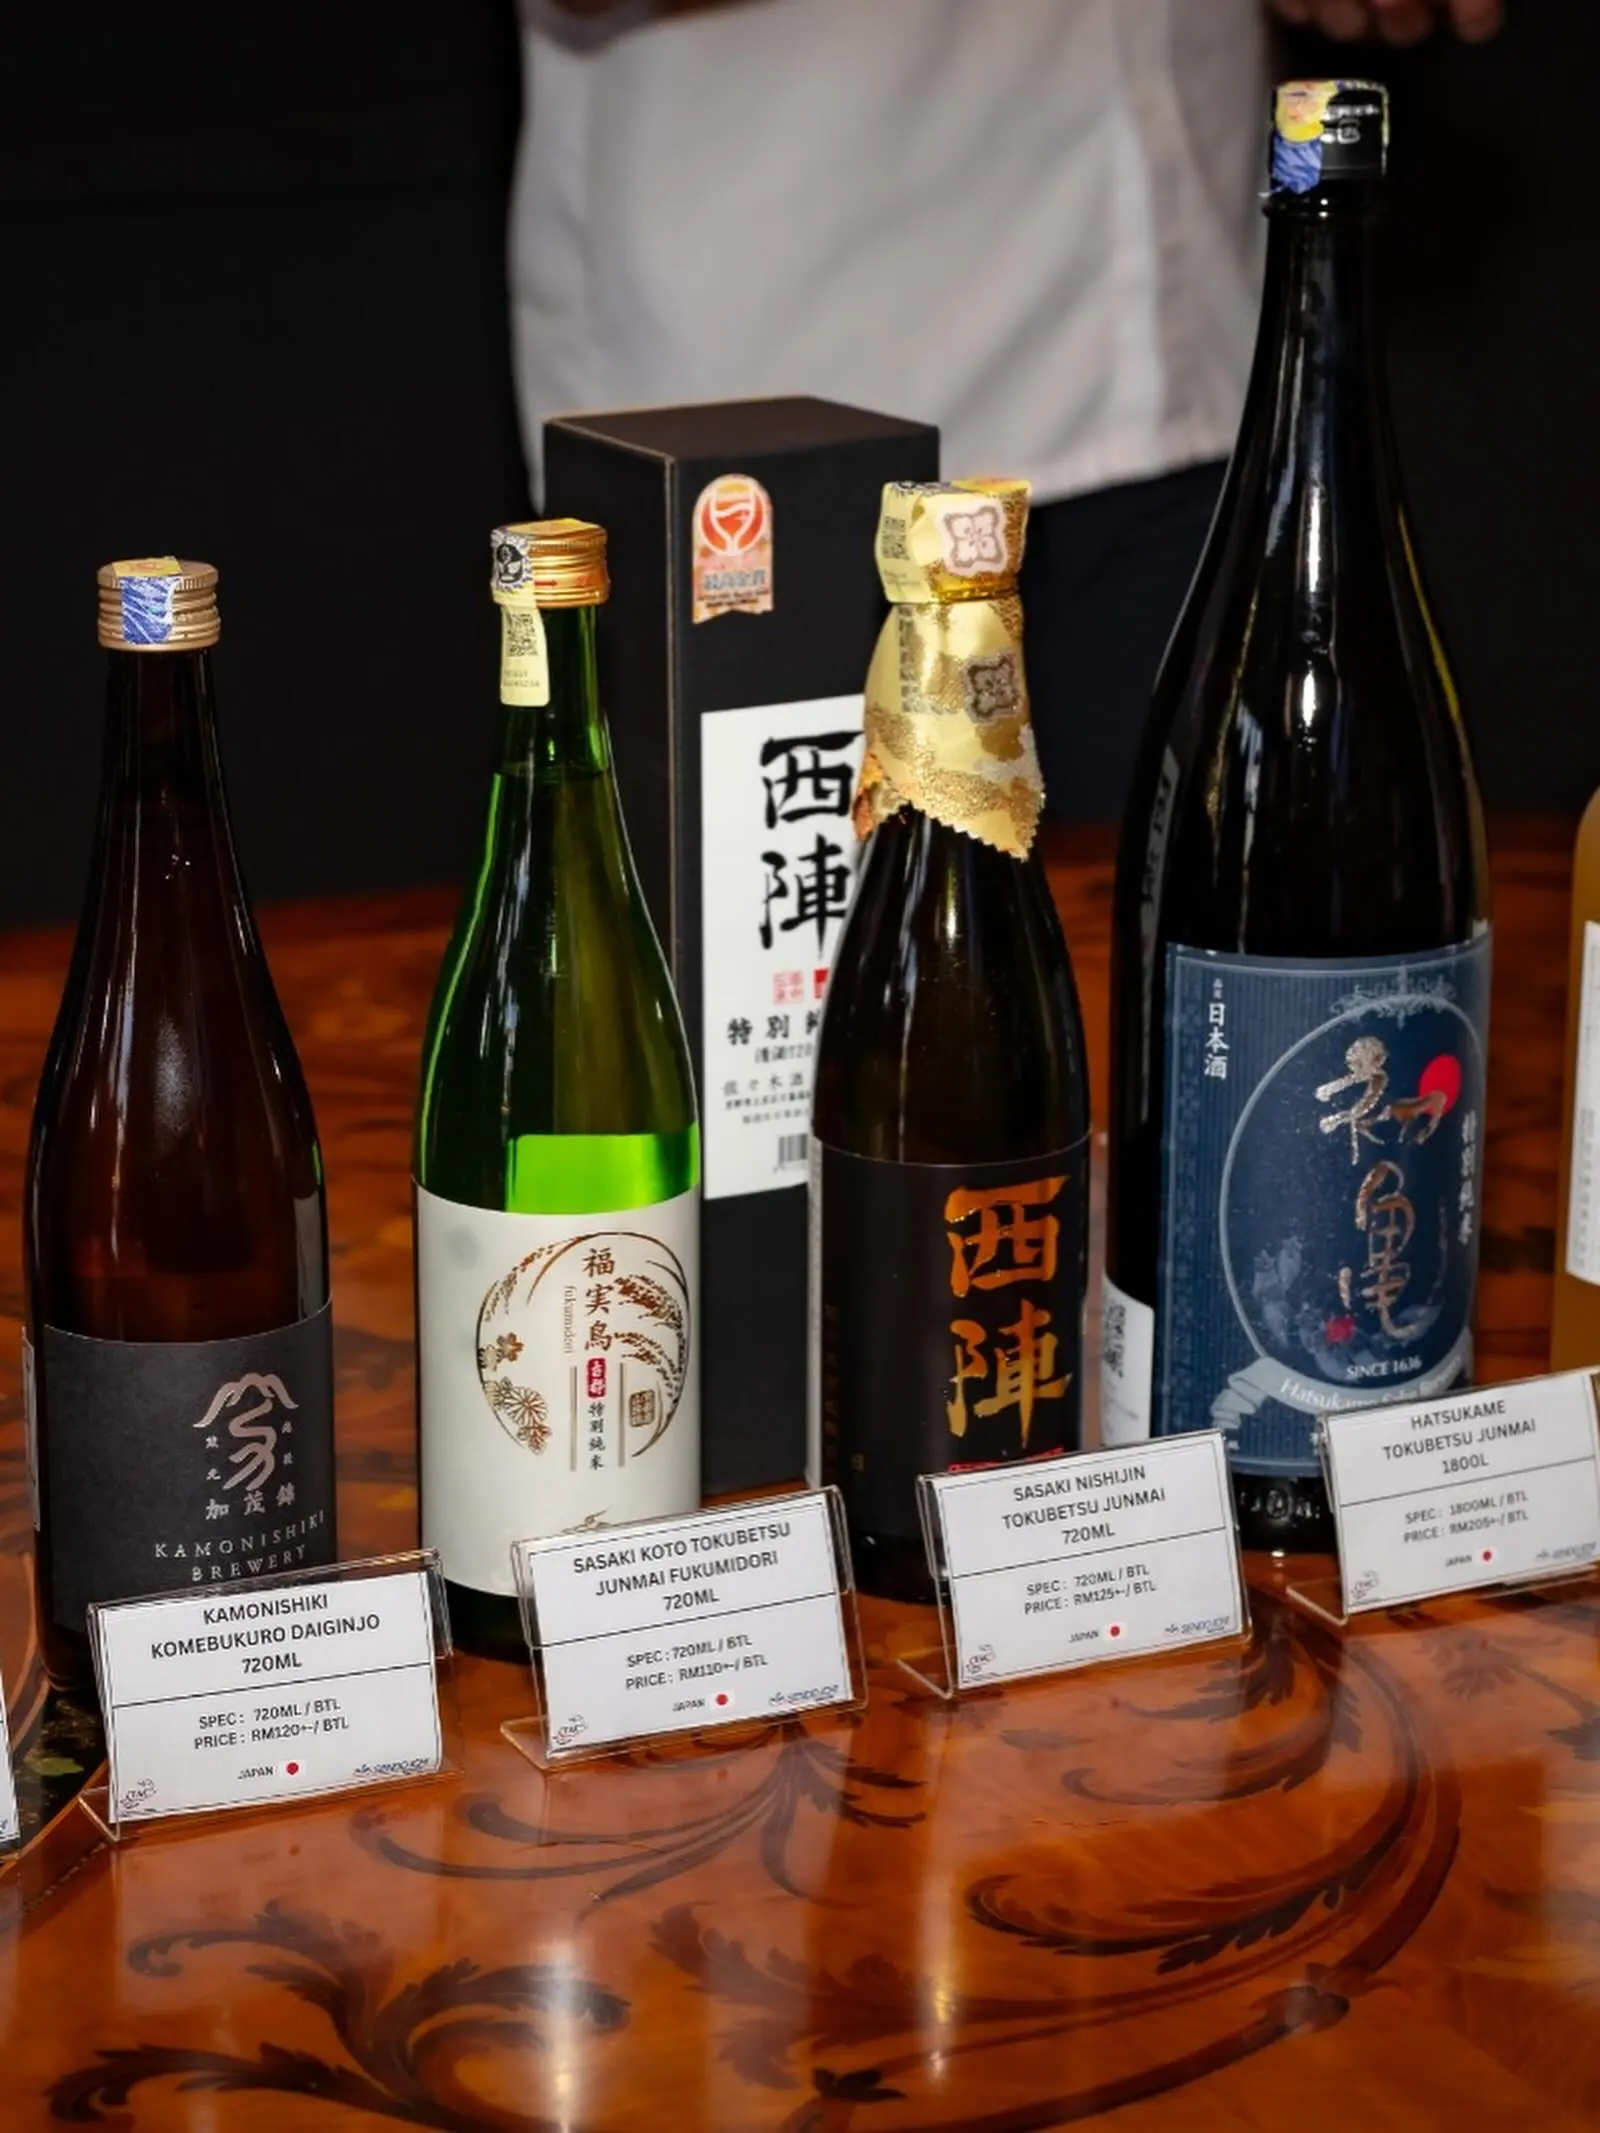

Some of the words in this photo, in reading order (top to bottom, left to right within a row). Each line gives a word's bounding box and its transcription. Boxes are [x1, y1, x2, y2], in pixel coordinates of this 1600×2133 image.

[759, 731, 865, 959] 西陣
[1203, 1003, 1230, 1079] 日本酒
[582, 1247, 615, 1351] 福実鳥
[945, 1174, 1072, 1448] 西陣
[564, 1286, 577, 1353] fukumidori
[1346, 1362, 1388, 1380] SINCE
[1411, 1400, 1506, 1430] HATSUKAME
[1384, 1431, 1473, 1460] TOKUBETSU
[1477, 1419, 1536, 1443] JUNMAI
[1442, 1454, 1489, 1474] 1800L
[1013, 1479, 1071, 1502] SASAKI
[1076, 1466, 1146, 1489] NISHIJIN
[1002, 1500, 1098, 1530] TOKUBETSU
[1102, 1488, 1166, 1512] JUNMAI
[1450, 1497, 1497, 1516] 1800ML
[1507, 1491, 1529, 1505] BTL
[1507, 1509, 1528, 1523] BTL
[155, 1510, 325, 1558] KAMONISHIKI
[1062, 1523, 1115, 1545] 720ML
[573, 1550, 636, 1574] SASAKI
[641, 1541, 687, 1562] KOTO
[690, 1522, 791, 1553] TOKUBETSU
[192, 1545, 305, 1582] BREWERY
[595, 1572, 666, 1596] JUNMAI
[670, 1551, 779, 1584] FUKUMIDORI
[1446, 1555, 1472, 1567] JAPAN
[1074, 1570, 1115, 1588] 720ML
[1127, 1564, 1150, 1578] BTL
[1134, 1580, 1157, 1594] BTL
[203, 1594, 328, 1625] KAMONISHIKI
[663, 1588, 720, 1611] 720ML
[151, 1626, 286, 1659] KOMEBUKURO
[291, 1615, 380, 1640] DAIGINJO
[672, 1641, 716, 1659] 720ML
[726, 1634, 752, 1649] BTL
[1069, 1629, 1099, 1643] JAPAN
[242, 1654, 302, 1674] 720ML
[743, 1654, 768, 1668] BTL
[254, 1706, 301, 1722] 720ML
[314, 1699, 341, 1713] BTL
[673, 1699, 705, 1712] JAPAN
[323, 1717, 349, 1731] BTL
[238, 1766, 274, 1780] JAPAN
